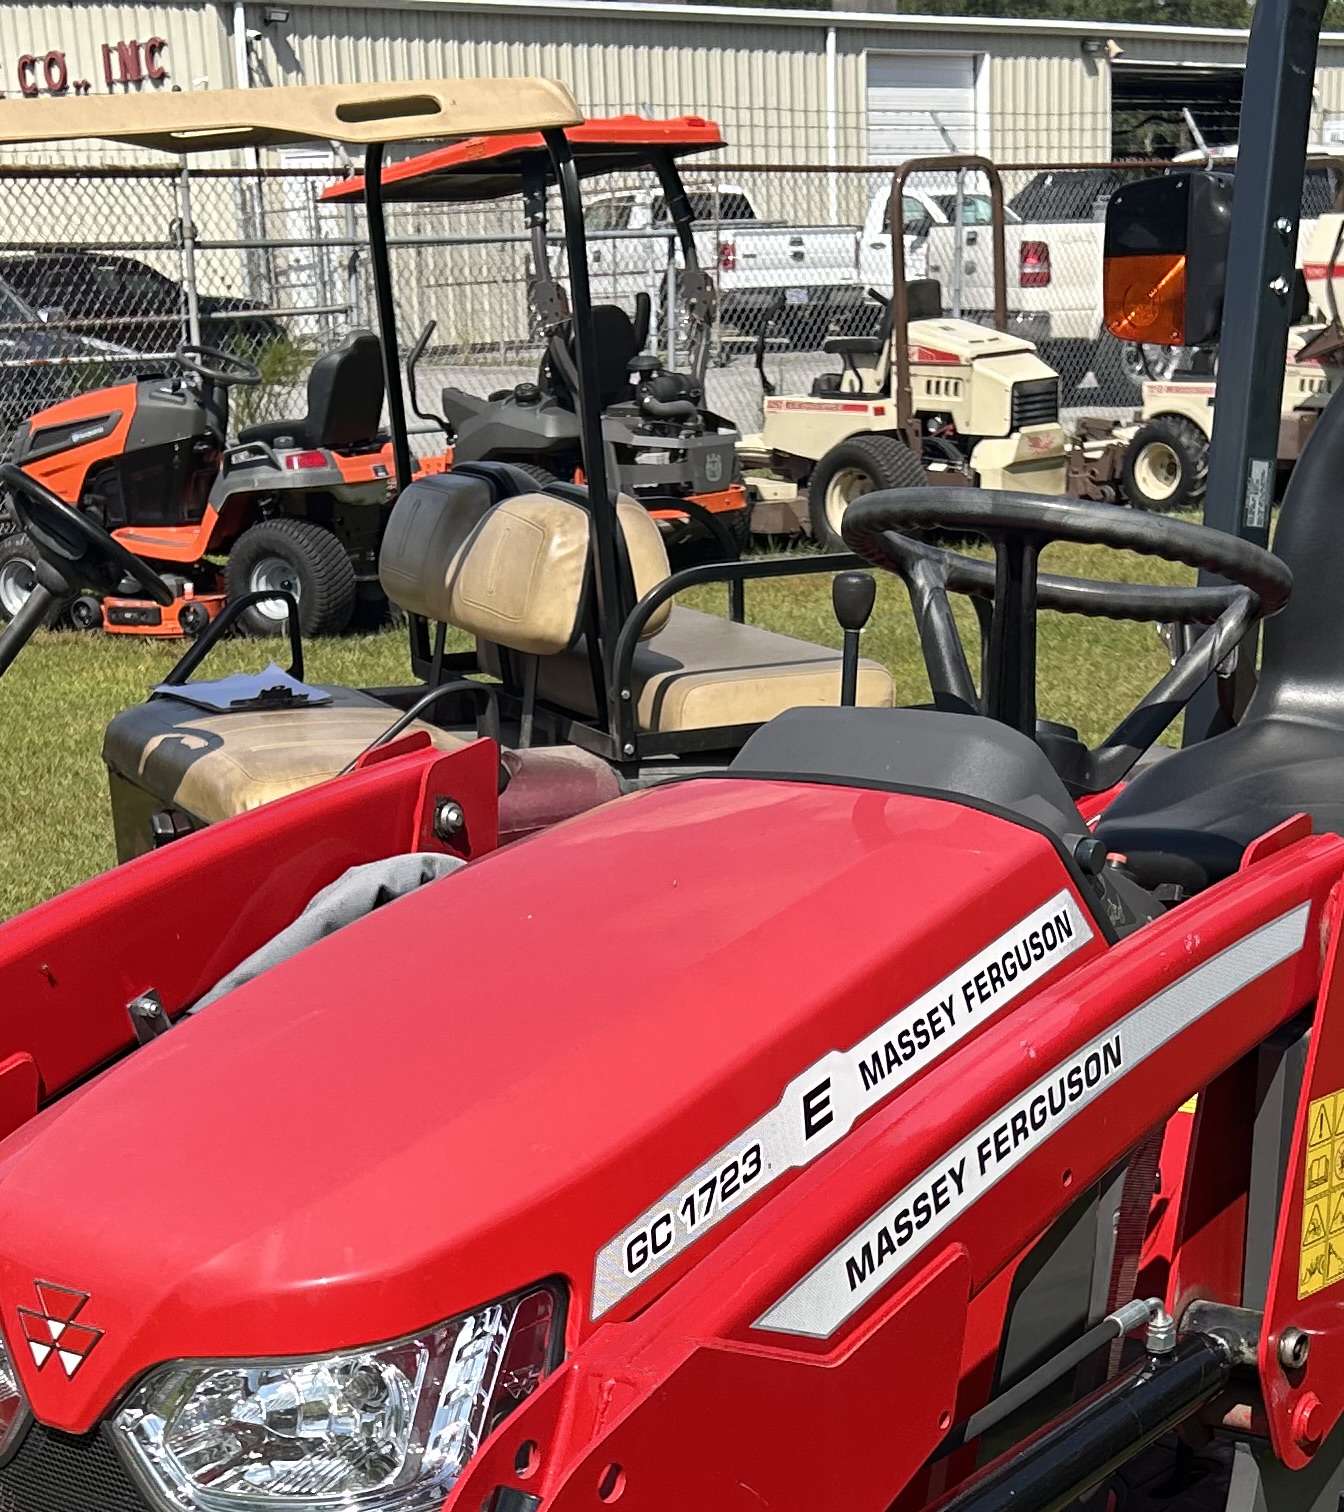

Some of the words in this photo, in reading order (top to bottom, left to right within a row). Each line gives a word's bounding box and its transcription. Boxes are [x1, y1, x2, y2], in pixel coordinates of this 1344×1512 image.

[102, 36, 164, 84] INC
[858, 994, 956, 1092] MASSEY
[961, 910, 1074, 1013] FERGUSON
[626, 1218, 673, 1273] GC
[680, 1143, 762, 1227] 1723
[802, 1077, 834, 1141] E
[845, 1157, 967, 1292] MASSEY
[976, 1035, 1122, 1175] FERGUSON
